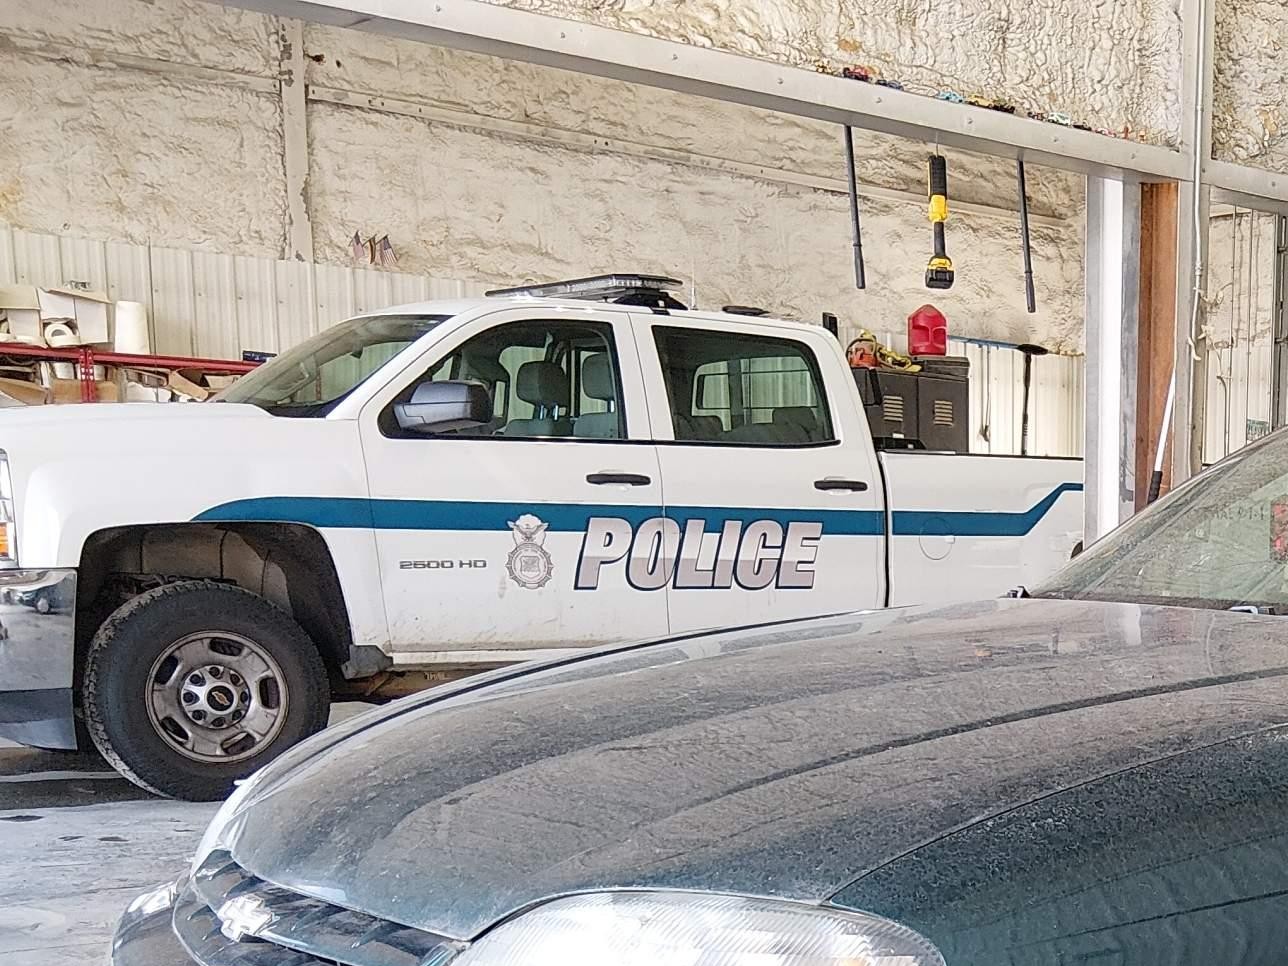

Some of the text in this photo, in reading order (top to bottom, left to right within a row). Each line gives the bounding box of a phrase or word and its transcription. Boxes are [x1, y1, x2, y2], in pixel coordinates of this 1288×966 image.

[399, 559, 488, 569] 2500 HD
[574, 516, 824, 592] POLICE
